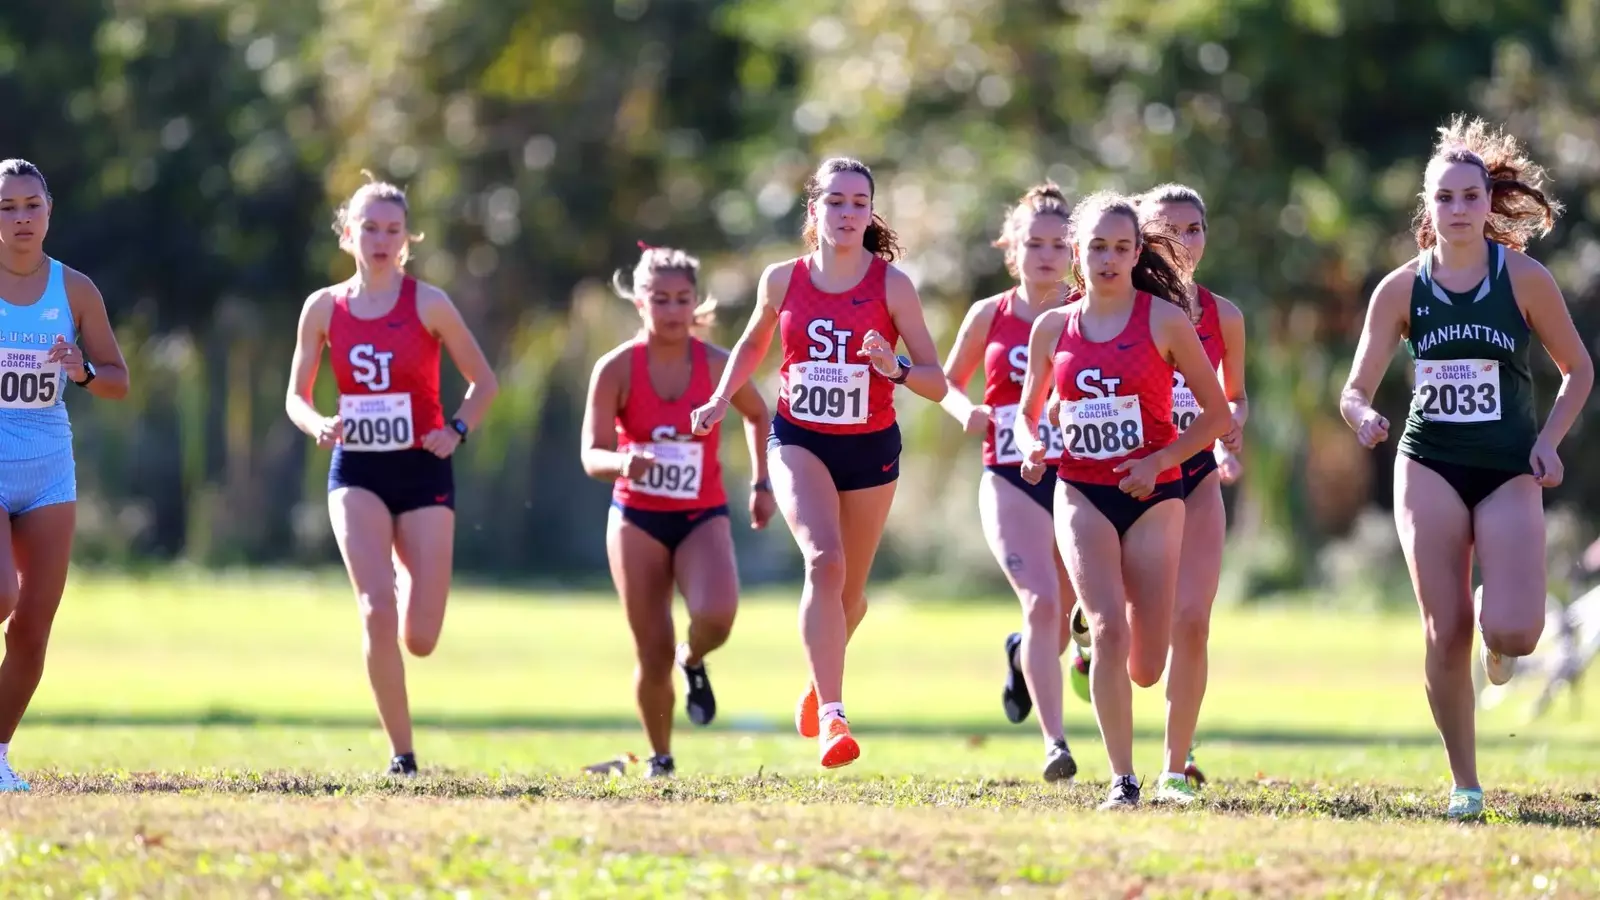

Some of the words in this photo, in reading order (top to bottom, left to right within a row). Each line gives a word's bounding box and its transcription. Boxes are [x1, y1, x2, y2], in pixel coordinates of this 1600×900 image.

[1418, 323, 1515, 358] MANHATTAN
[7, 353, 37, 362] SHORE
[0, 360, 42, 370] COACHES
[1441, 364, 1471, 373] SHORE
[813, 366, 844, 376] SHORE
[1435, 371, 1478, 380] COACHES
[808, 373, 849, 384] COACHES
[791, 384, 861, 418] 2091
[1420, 383, 1497, 416] 2033
[1084, 402, 1112, 412] SHORE
[1078, 409, 1119, 420] COACHES
[344, 417, 409, 445] 2090
[1065, 419, 1140, 454] 2088
[999, 423, 1065, 456] 293
